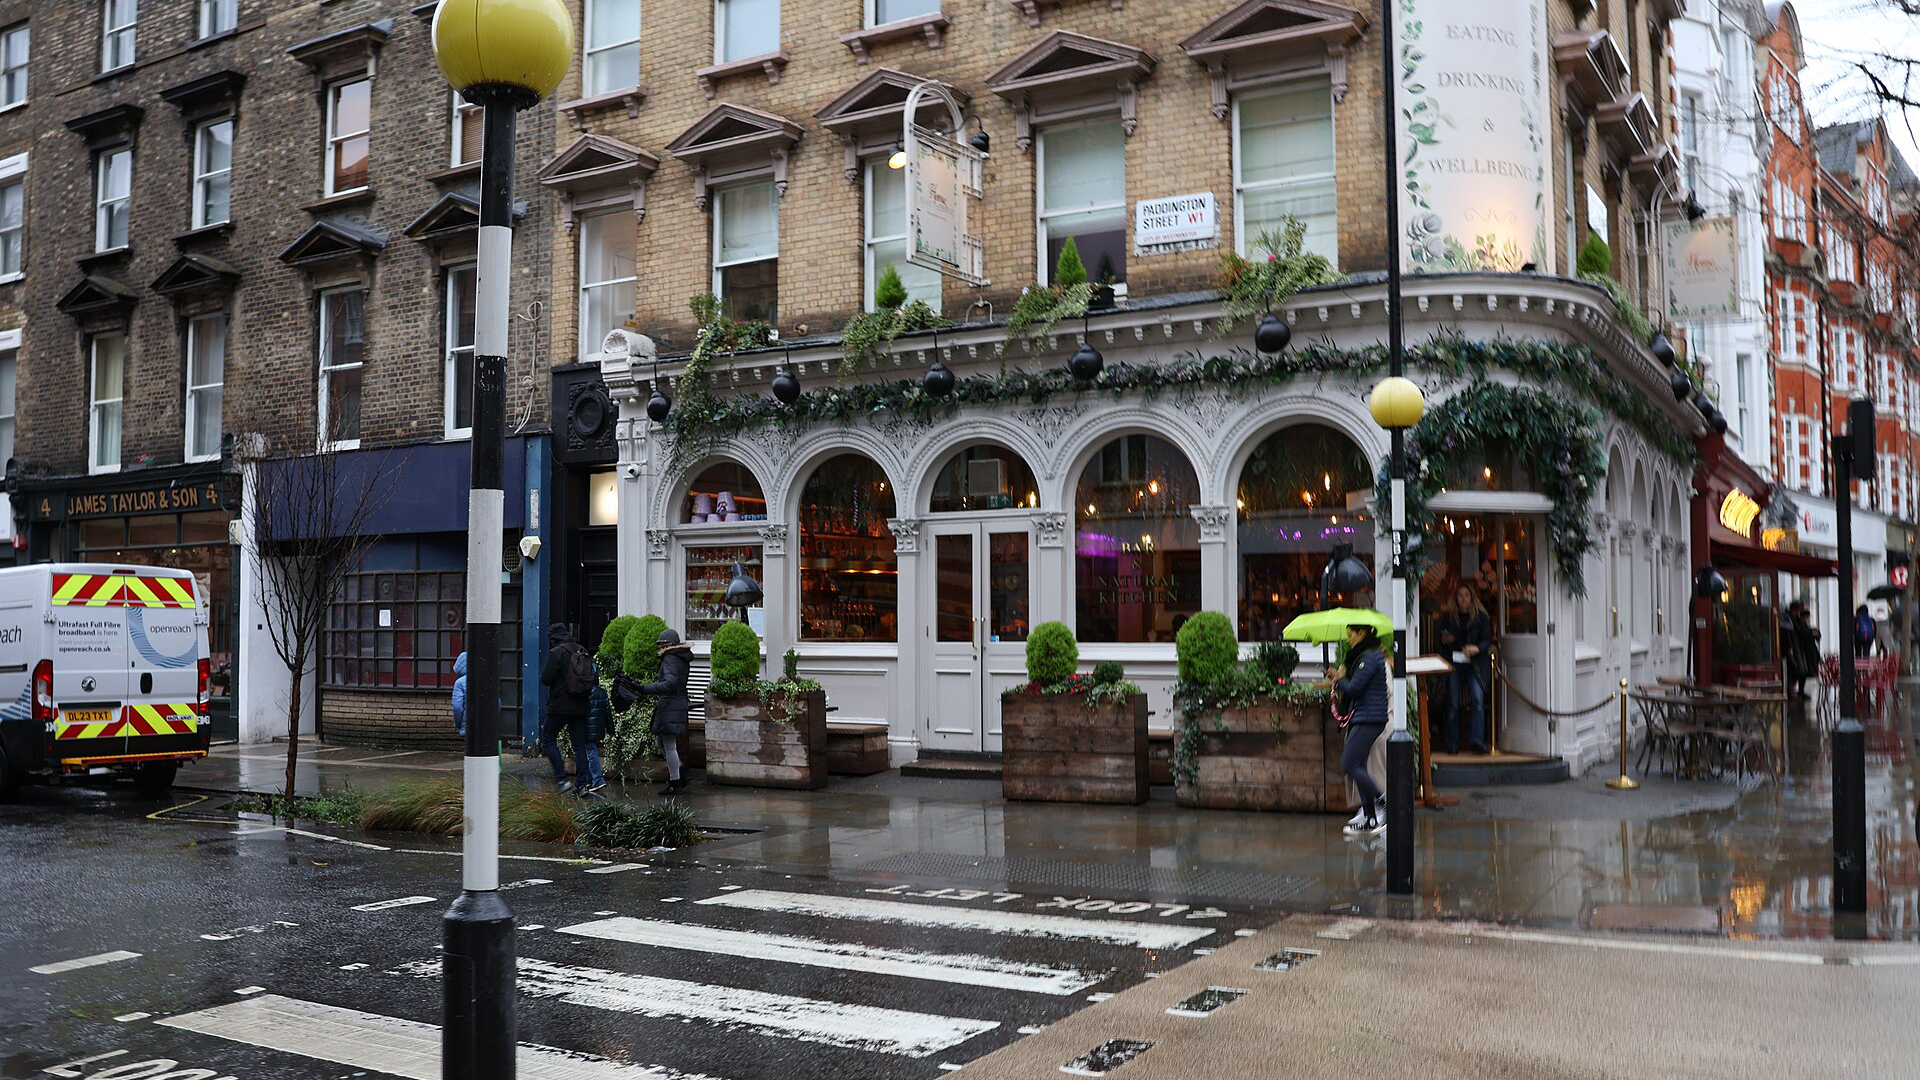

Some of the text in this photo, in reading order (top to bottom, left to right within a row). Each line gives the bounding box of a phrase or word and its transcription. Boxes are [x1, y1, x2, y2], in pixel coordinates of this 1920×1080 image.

[1437, 72, 1526, 95] DRINKING
[1483, 117, 1495, 132] &
[1428, 158, 1534, 181] WELLBEING
[1143, 197, 1206, 216] PADDINGTON
[1143, 212, 1204, 230] STREET W1
[67, 487, 198, 516] JAMES TAYLOR & SON
[205, 483, 218, 505] 4
[41, 498, 51, 517] 4
[1121, 542, 1156, 554] BAR
[1098, 573, 1179, 589] NATURAL
[1099, 590, 1178, 604] KITCHEN
[150, 624, 192, 634] openreach
[68, 710, 109, 722] DL23 TXT
[865, 885, 1191, 917] LOOK LEFT
